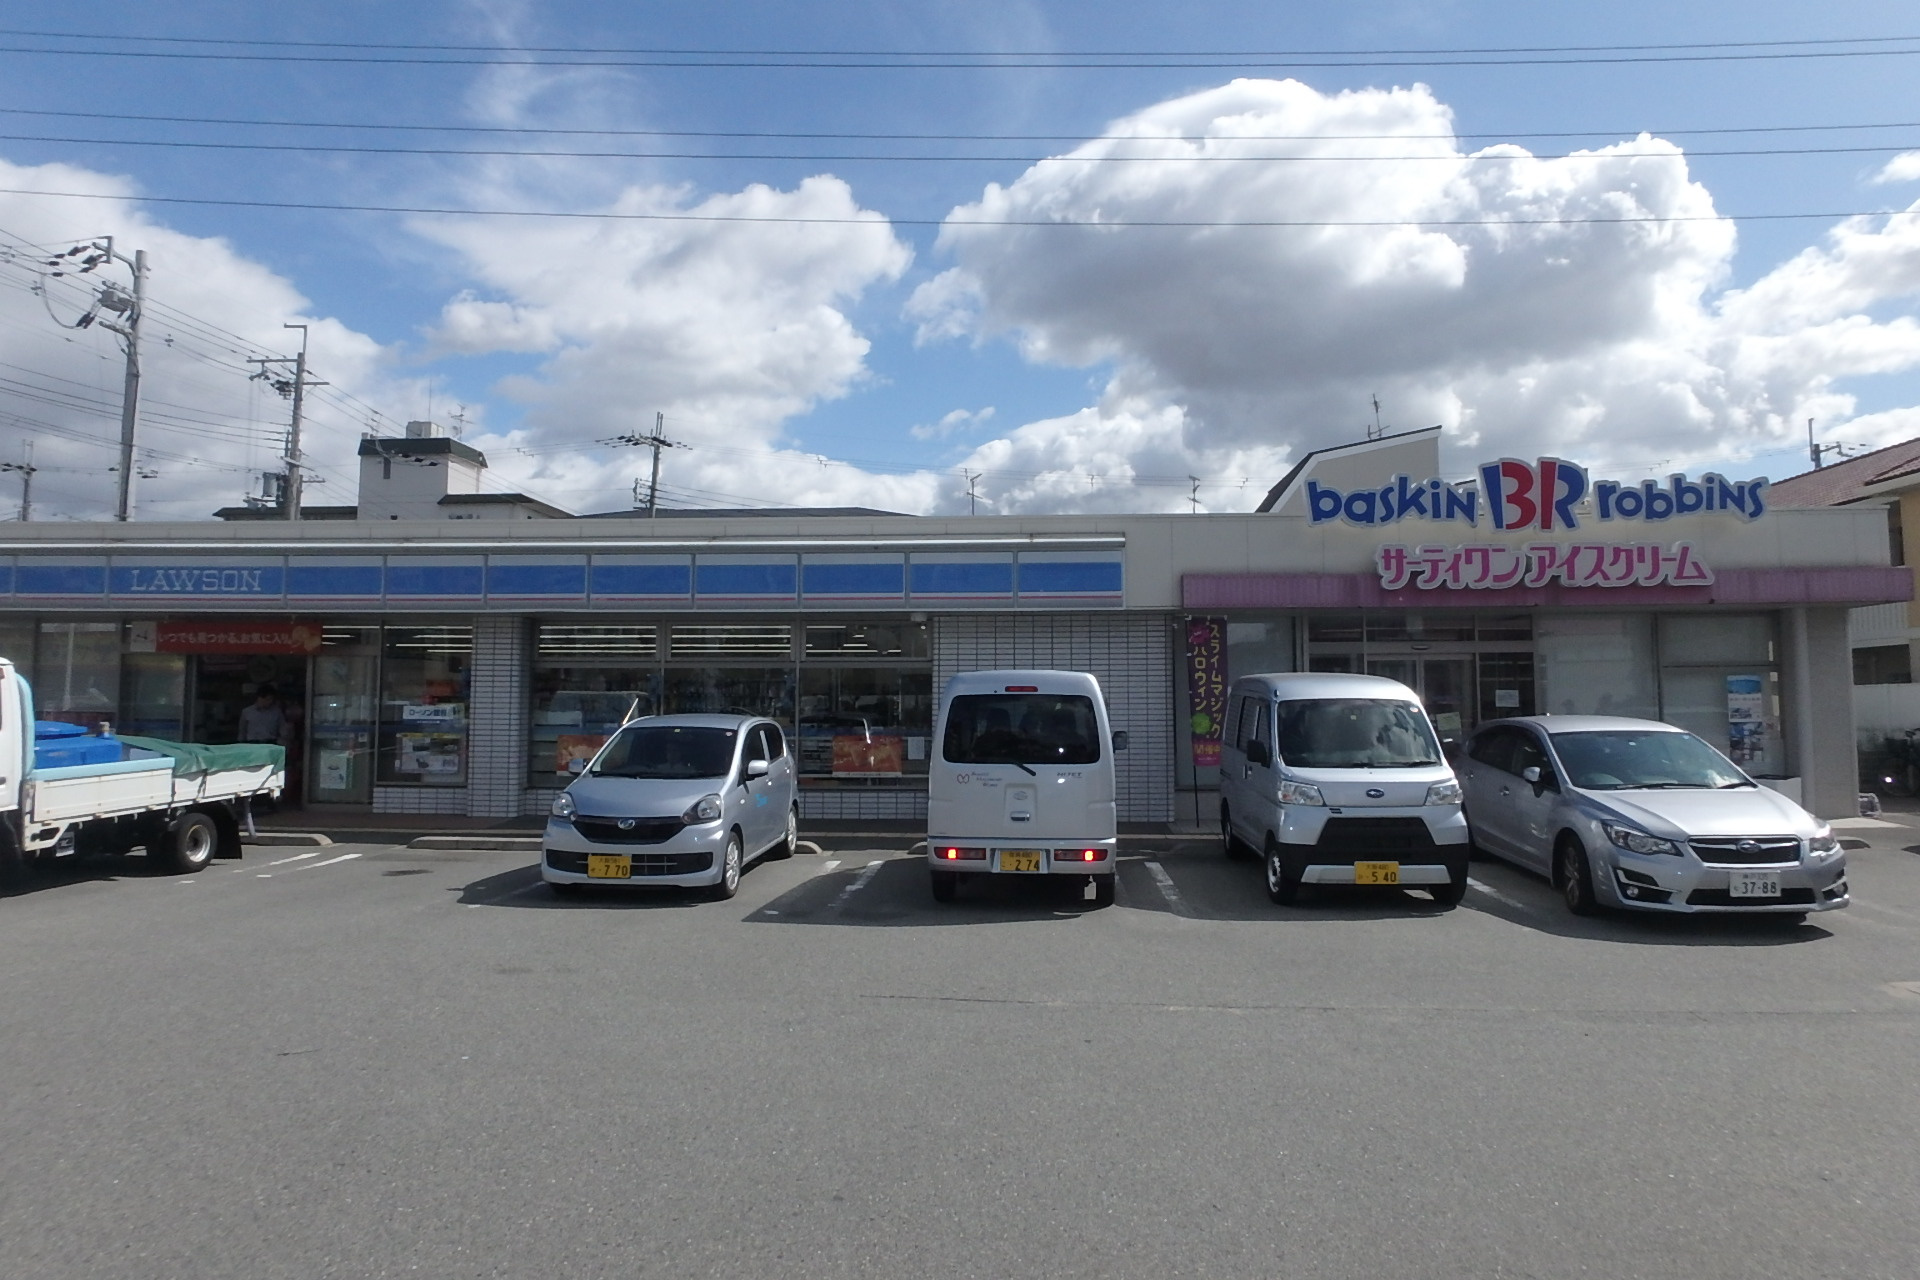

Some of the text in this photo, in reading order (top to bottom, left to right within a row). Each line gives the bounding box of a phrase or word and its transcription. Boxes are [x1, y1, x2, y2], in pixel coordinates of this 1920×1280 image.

[1482, 461, 1585, 530] BR
[131, 569, 262, 591] LAWSON
[1194, 646, 1208, 711] ハロウィン
[1210, 624, 1224, 739] スライムマジック
[1015, 859, 1040, 871] 274
[1742, 881, 1777, 894] 37-88
